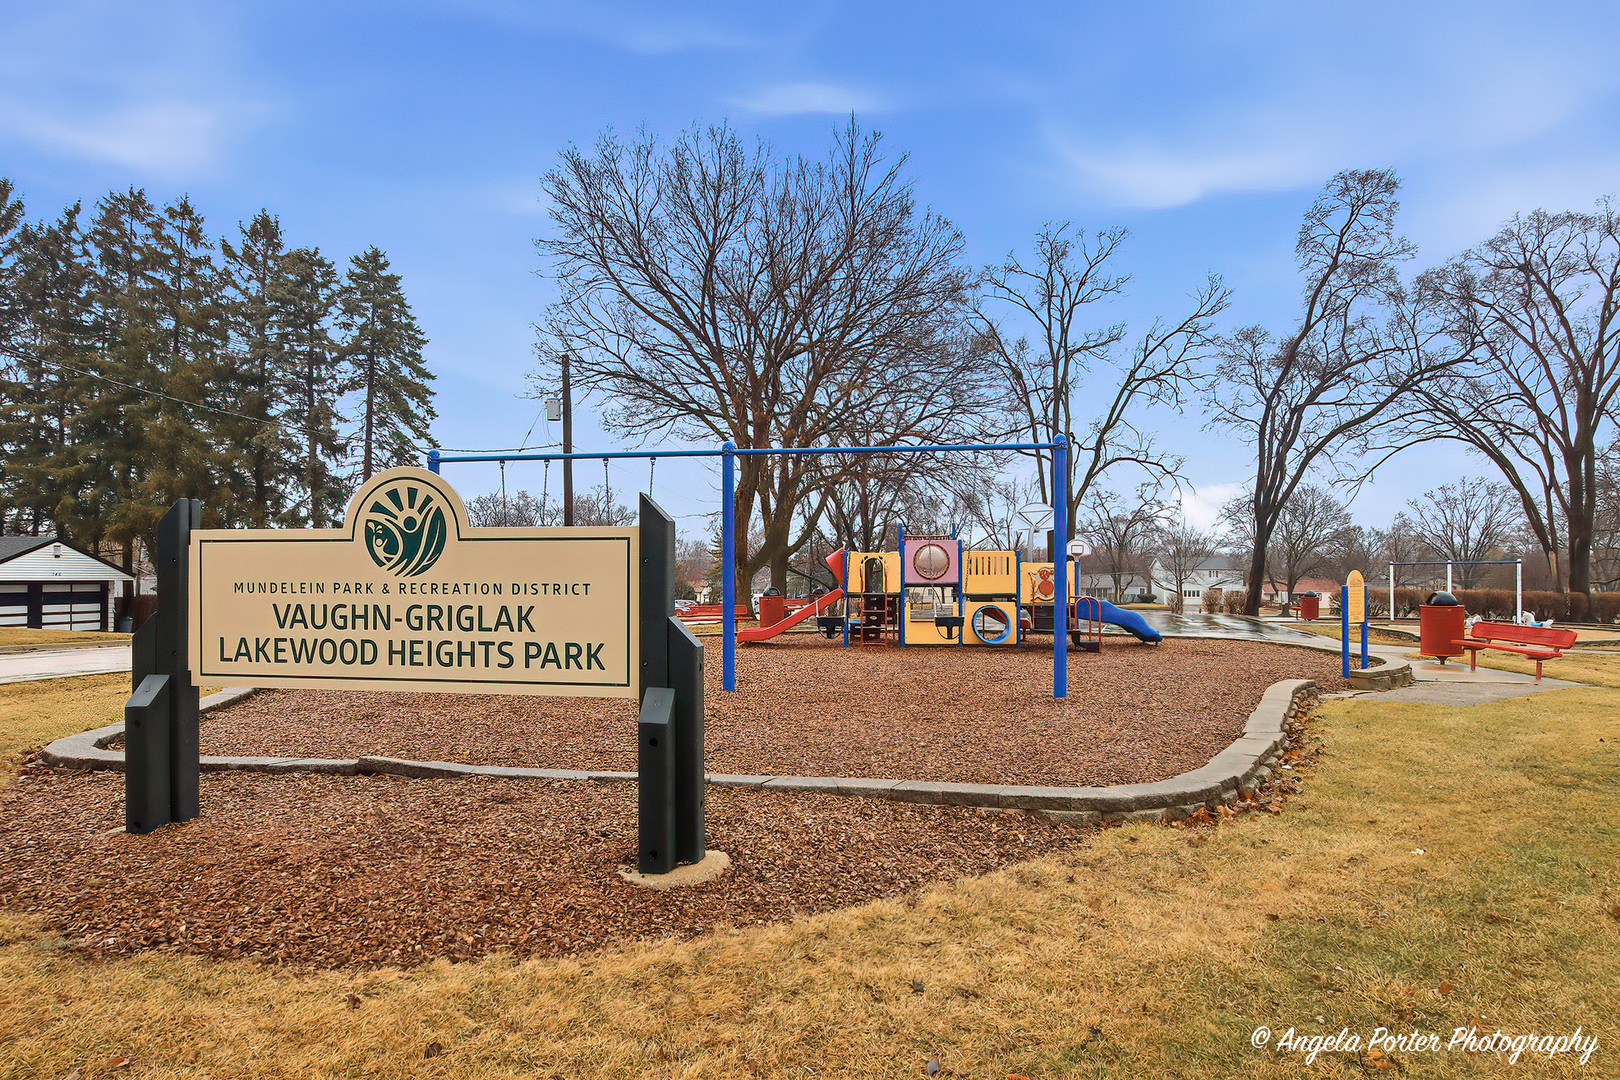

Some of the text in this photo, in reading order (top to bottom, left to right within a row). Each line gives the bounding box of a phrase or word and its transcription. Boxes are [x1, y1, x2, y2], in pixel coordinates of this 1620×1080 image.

[233, 581, 592, 596] MUNDELEIN PARK & RECREATION DISTRICT
[271, 603, 536, 633] VAUGHN-GRIGLAK
[219, 636, 606, 671] LAKEWOOD HEIGHTS PARK
